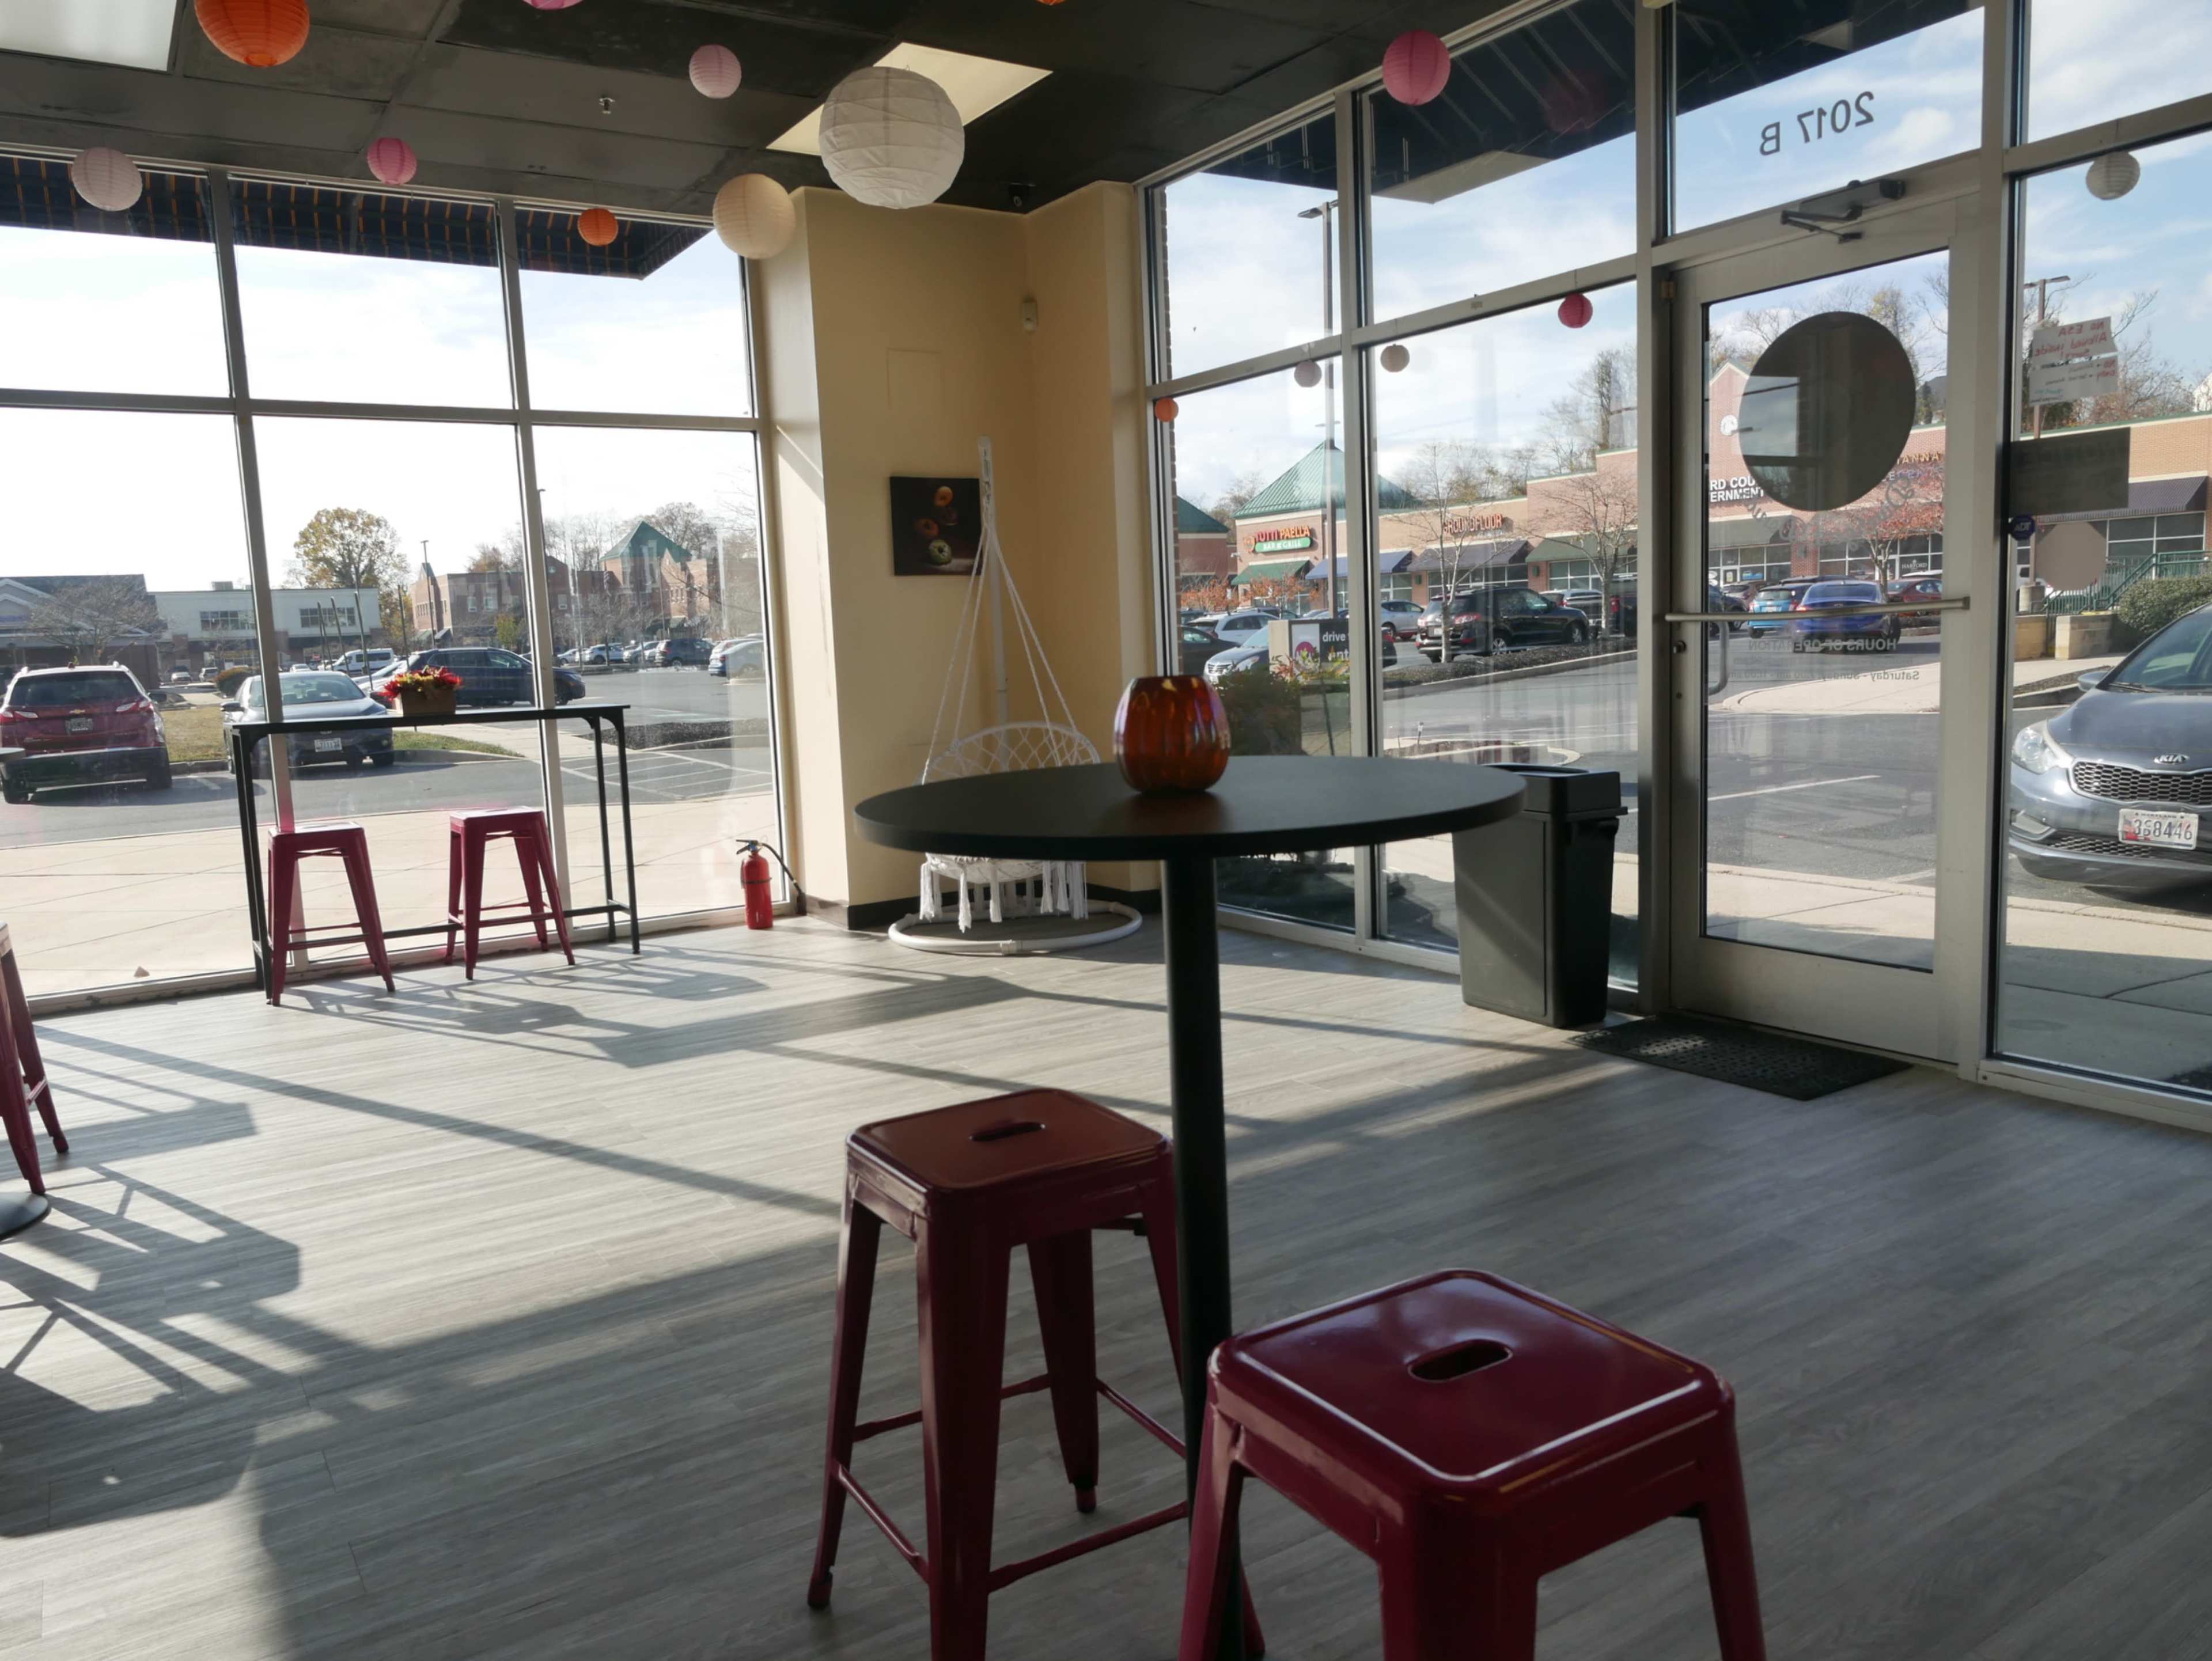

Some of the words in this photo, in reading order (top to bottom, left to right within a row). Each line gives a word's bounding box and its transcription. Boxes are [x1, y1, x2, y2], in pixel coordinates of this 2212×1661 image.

[2013, 522, 2032, 532] ADT
[1279, 525, 1310, 540] PAELLA
[1282, 539, 1301, 549] GRILL
[1322, 631, 1346, 642] drive
[2158, 754, 2182, 763] KIA
